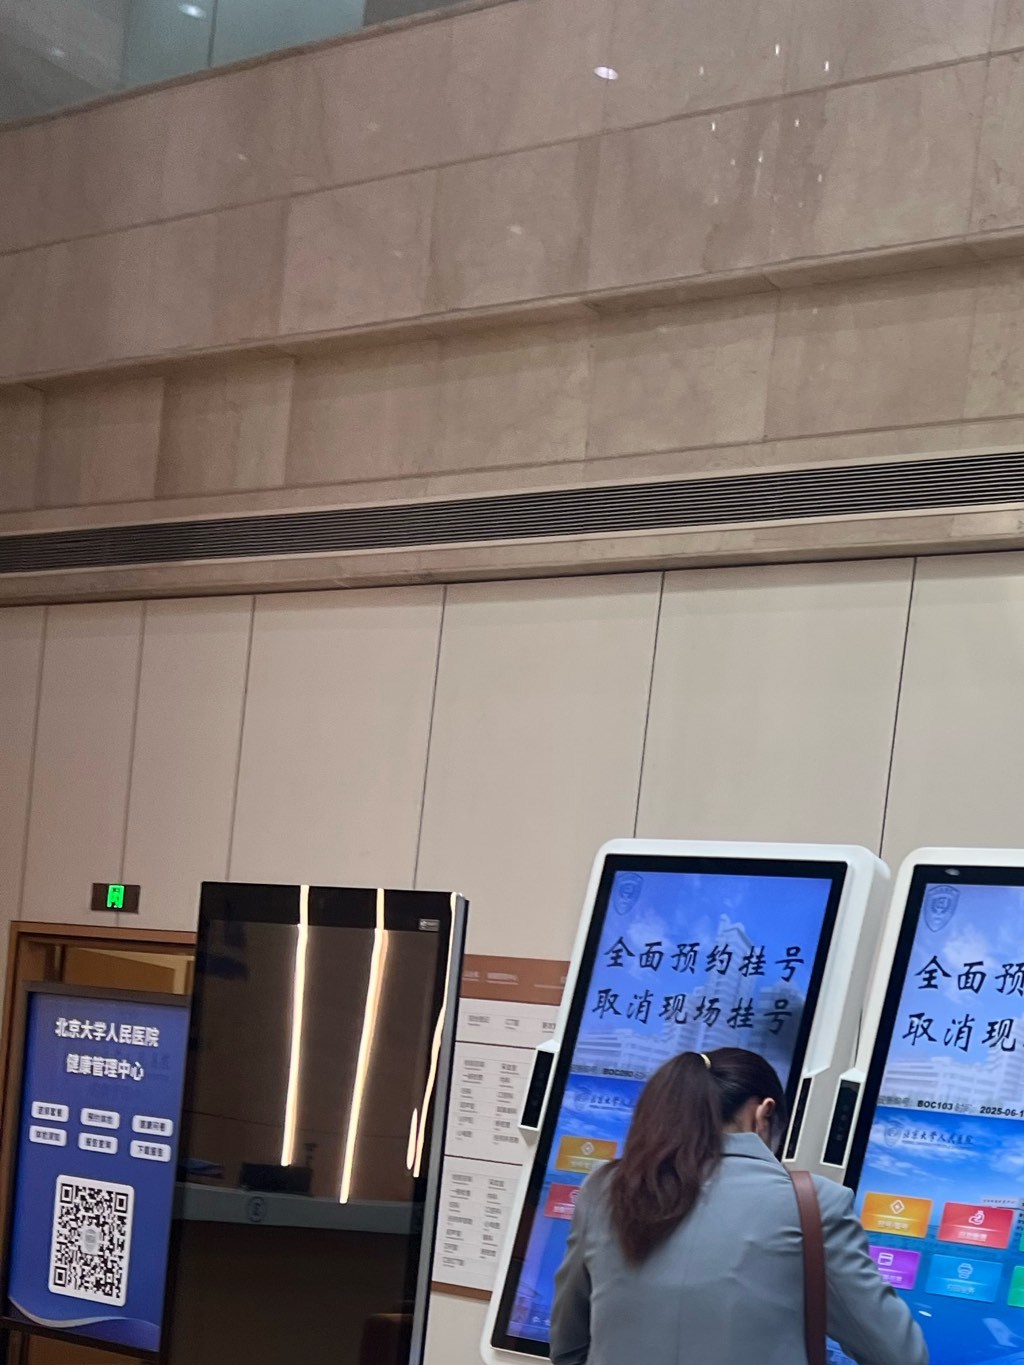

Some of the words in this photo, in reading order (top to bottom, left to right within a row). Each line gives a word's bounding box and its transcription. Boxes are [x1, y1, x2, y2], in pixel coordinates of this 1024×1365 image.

[603, 936, 805, 983] 全面预约挂号
[592, 987, 793, 1035] 取消现场挂号
[55, 1017, 160, 1047] 北京大学人民医院
[66, 1053, 144, 1081] 健康管理中心
[917, 1099, 953, 1111] BOC103
